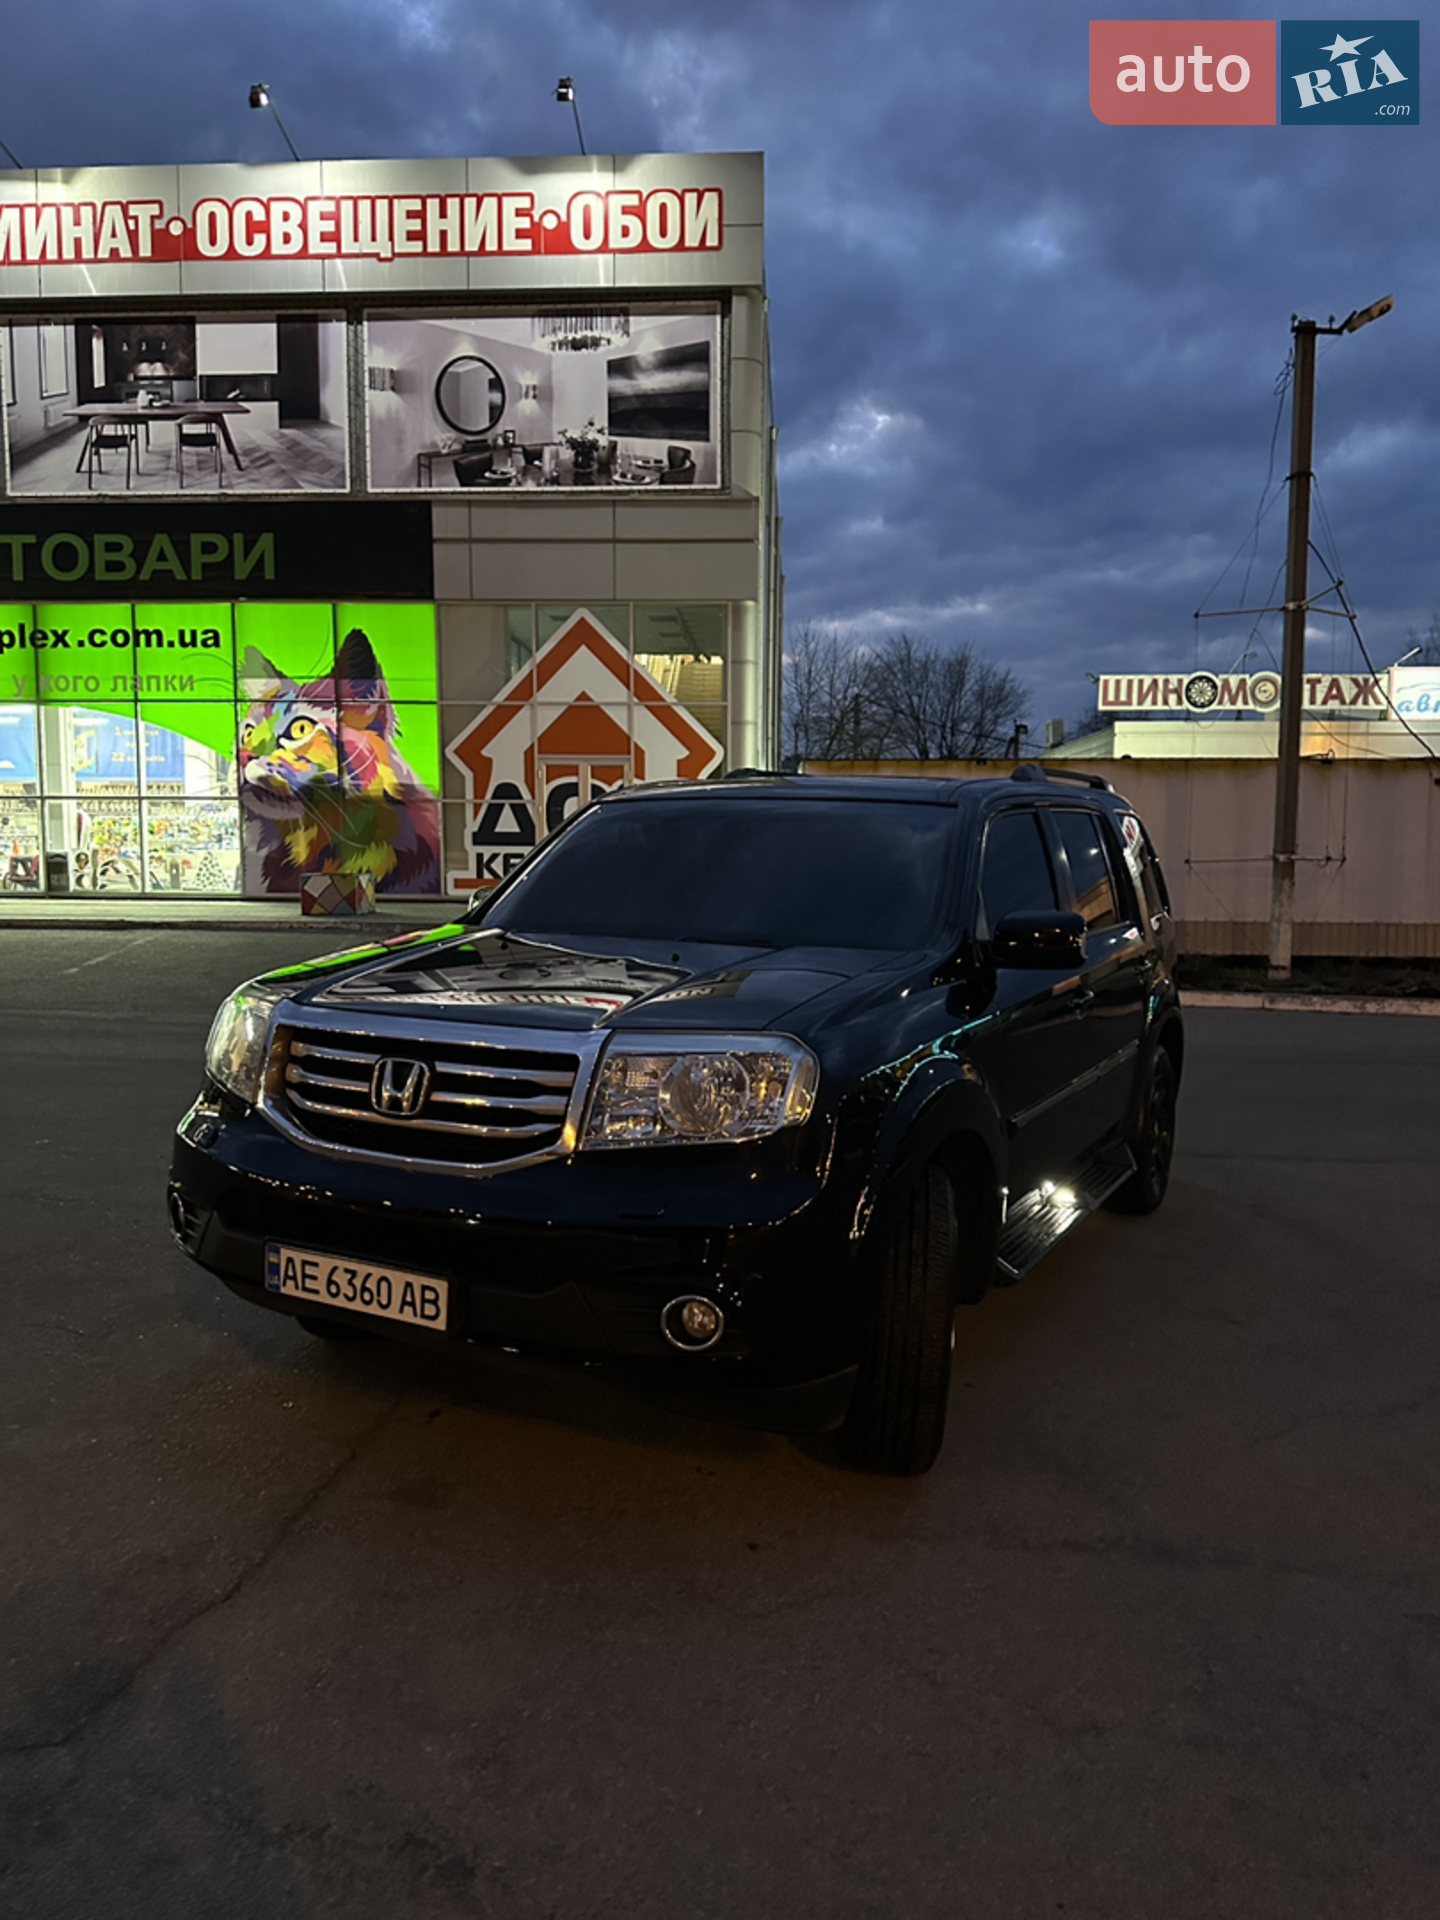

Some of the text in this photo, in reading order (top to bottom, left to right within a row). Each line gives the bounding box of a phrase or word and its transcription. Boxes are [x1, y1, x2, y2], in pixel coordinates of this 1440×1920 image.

[195, 195, 533, 258] ОСВЕЩЕНИЕ
[569, 191, 719, 251] ОБОИ
[0, 532, 276, 581] ТОВАРИ
[110, 673, 196, 693] лапки
[282, 1256, 441, 1322] AE 6360 AB
